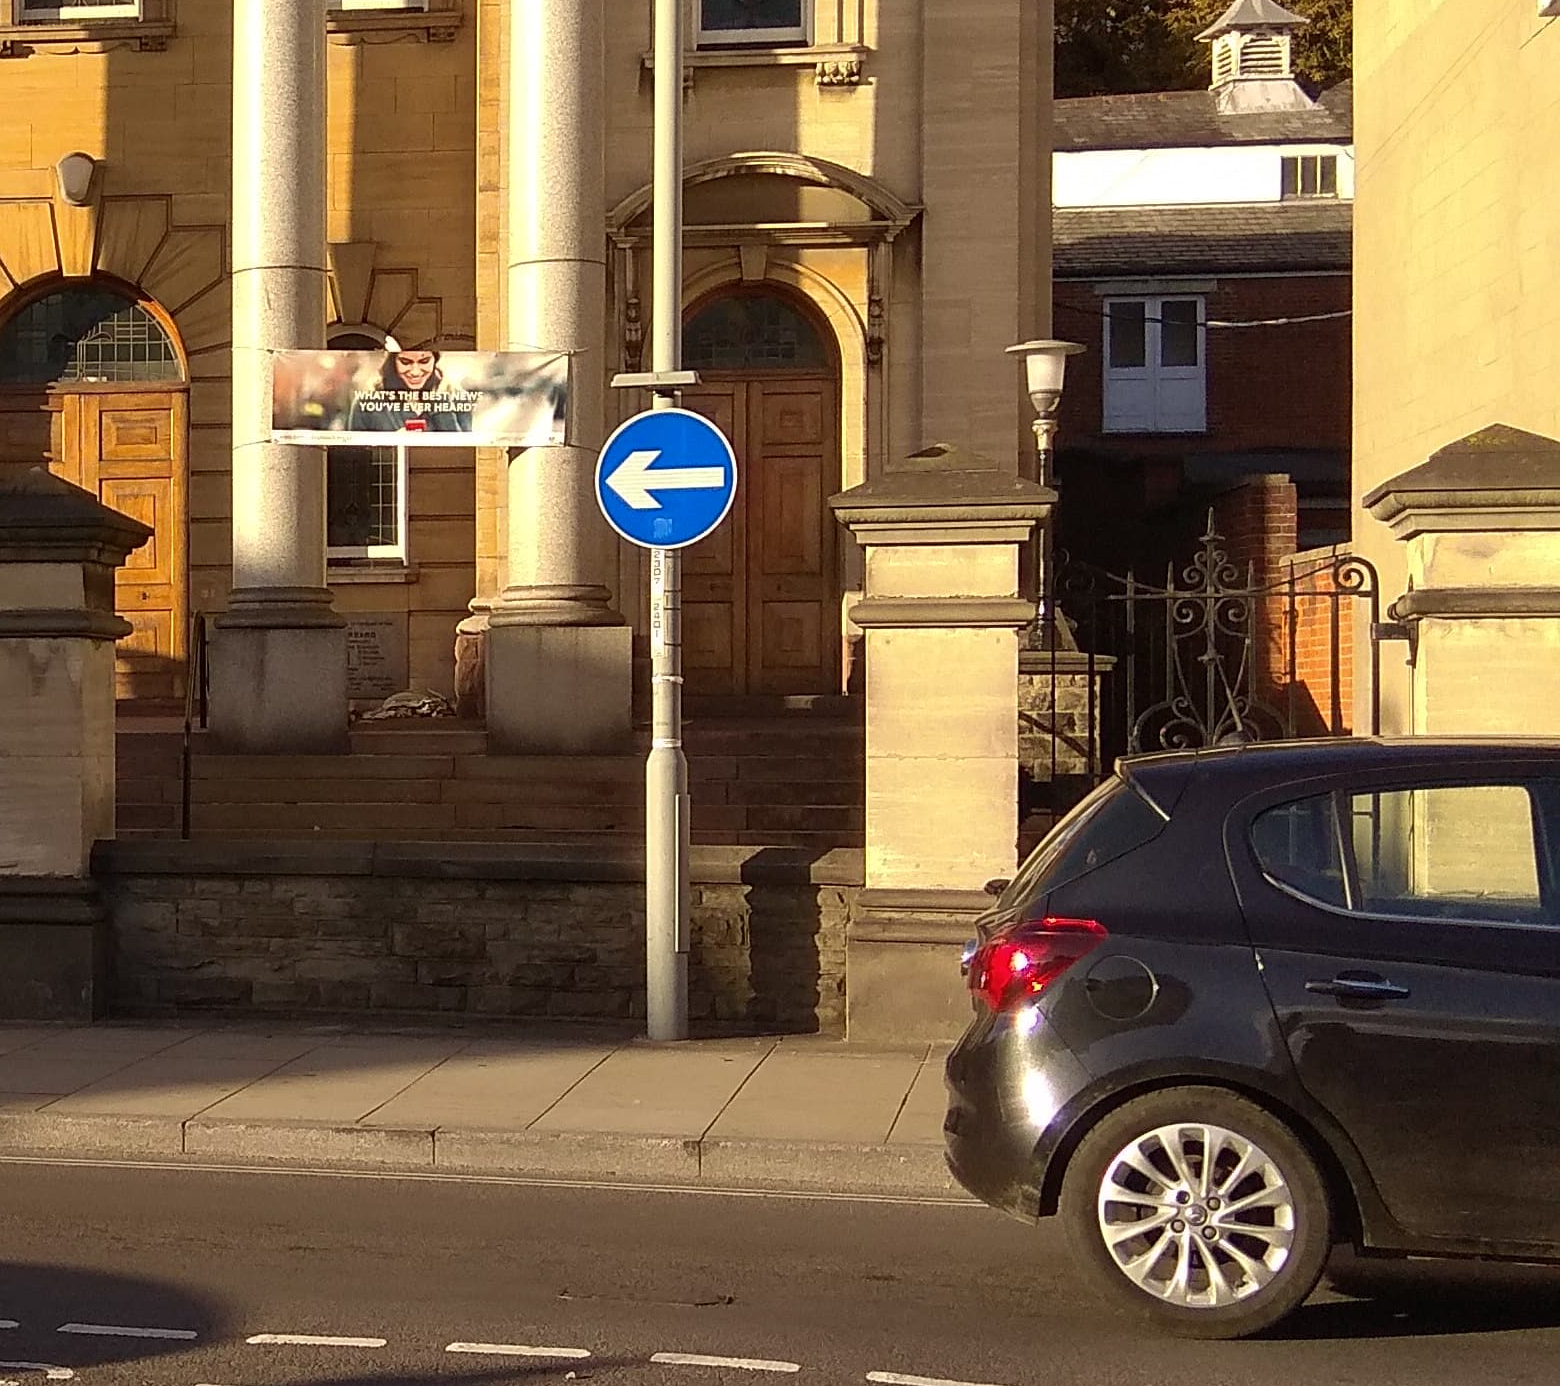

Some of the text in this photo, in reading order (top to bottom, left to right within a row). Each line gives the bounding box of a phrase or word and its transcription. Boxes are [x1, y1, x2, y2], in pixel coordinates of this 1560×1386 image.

[354, 390, 483, 401] WHAT'S THE BEST NEWS
[359, 401, 478, 412] YOU'VE EVER HEARD?
